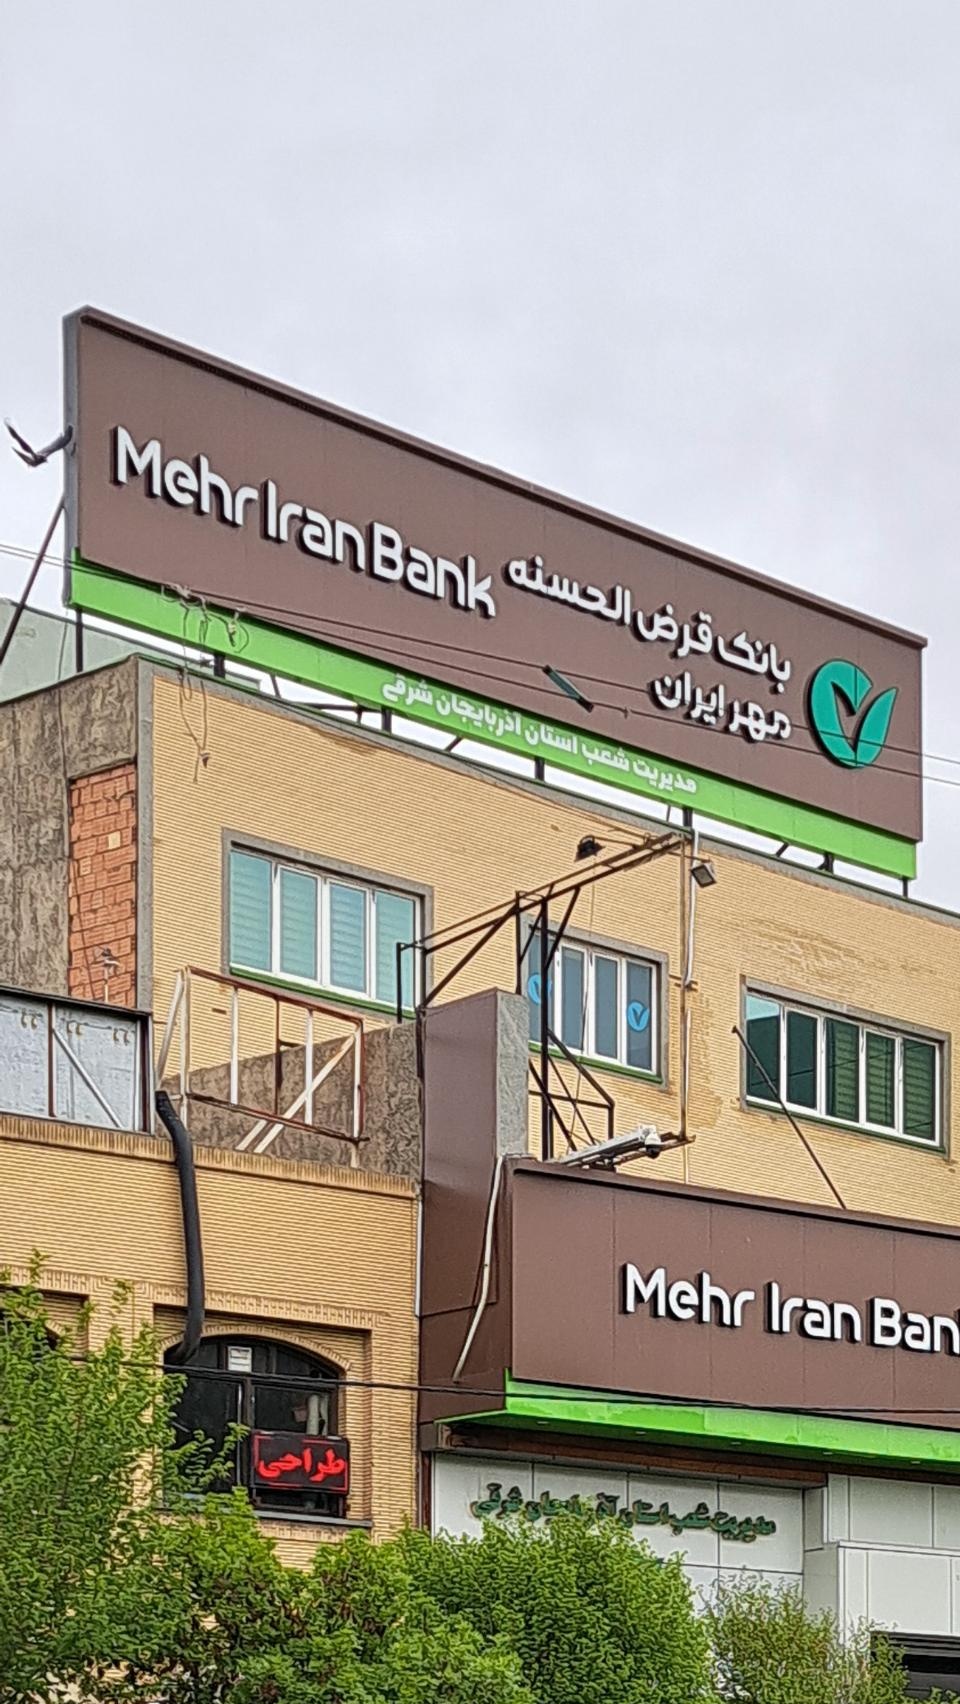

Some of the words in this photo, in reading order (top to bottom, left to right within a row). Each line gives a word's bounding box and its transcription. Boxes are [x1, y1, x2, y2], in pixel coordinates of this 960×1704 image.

[115, 425, 259, 527] Mehr
[266, 479, 366, 572] Iran
[372, 520, 497, 618] Bank
[507, 554, 632, 627] الحسنه
[636, 603, 713, 658] قرض
[716, 631, 792, 694] بانک
[381, 674, 434, 706] شرقی
[653, 671, 725, 727] ایران
[435, 694, 522, 738] آذربایجان
[728, 700, 792, 742] مهر
[523, 723, 579, 755] استان
[581, 742, 630, 772] شعب
[632, 759, 698, 794] مدیریت
[624, 1262, 756, 1328] Mehr
[770, 1281, 862, 1343] Iran
[258, 1447, 346, 1482] طراحی
